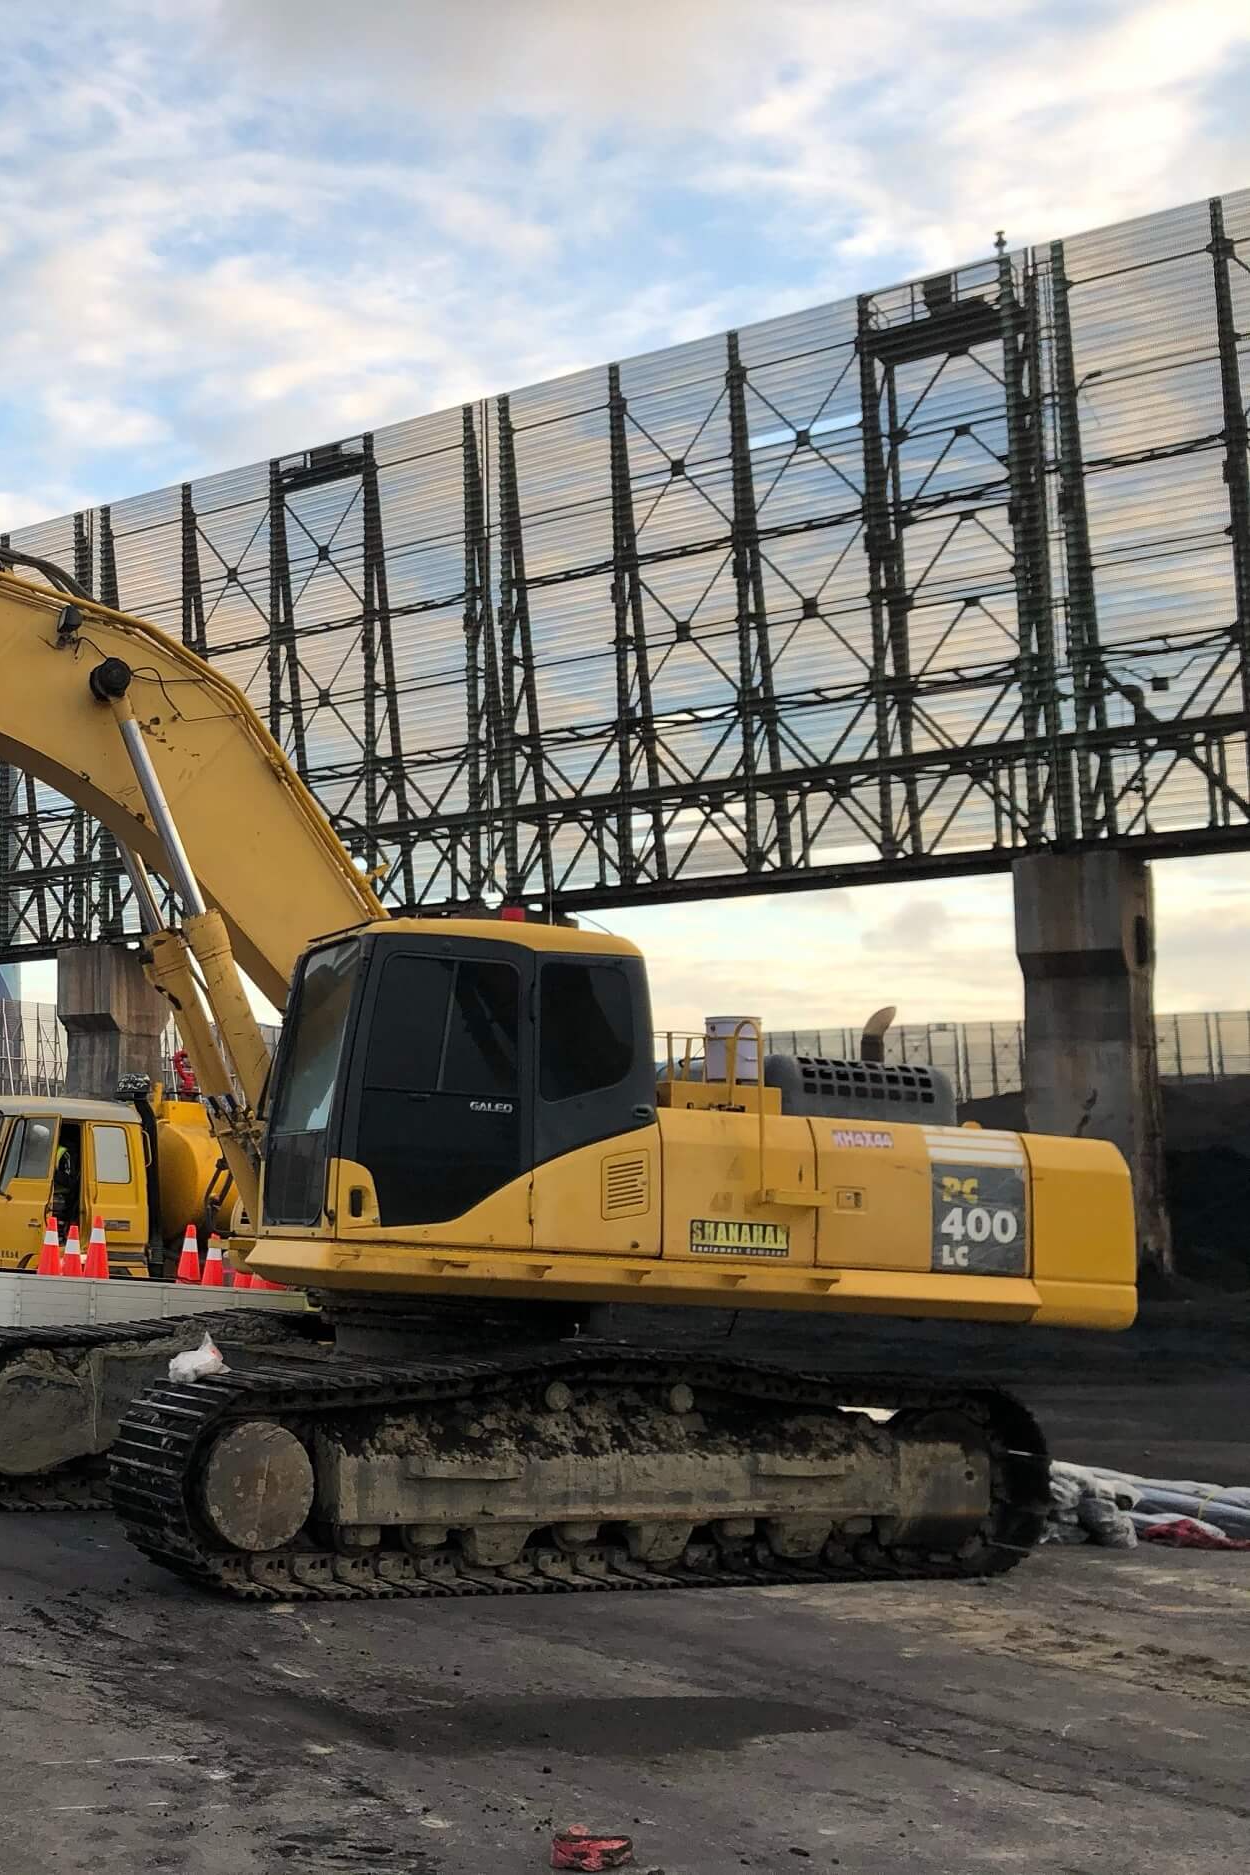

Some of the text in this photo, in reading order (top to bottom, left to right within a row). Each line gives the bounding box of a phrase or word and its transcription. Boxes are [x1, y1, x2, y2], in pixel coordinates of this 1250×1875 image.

[470, 1101, 513, 1113] GALEO
[942, 1176, 979, 1204] PC
[692, 1221, 788, 1249] SHANAHAN
[941, 1207, 1017, 1244] 400
[942, 1245, 969, 1267] LC
